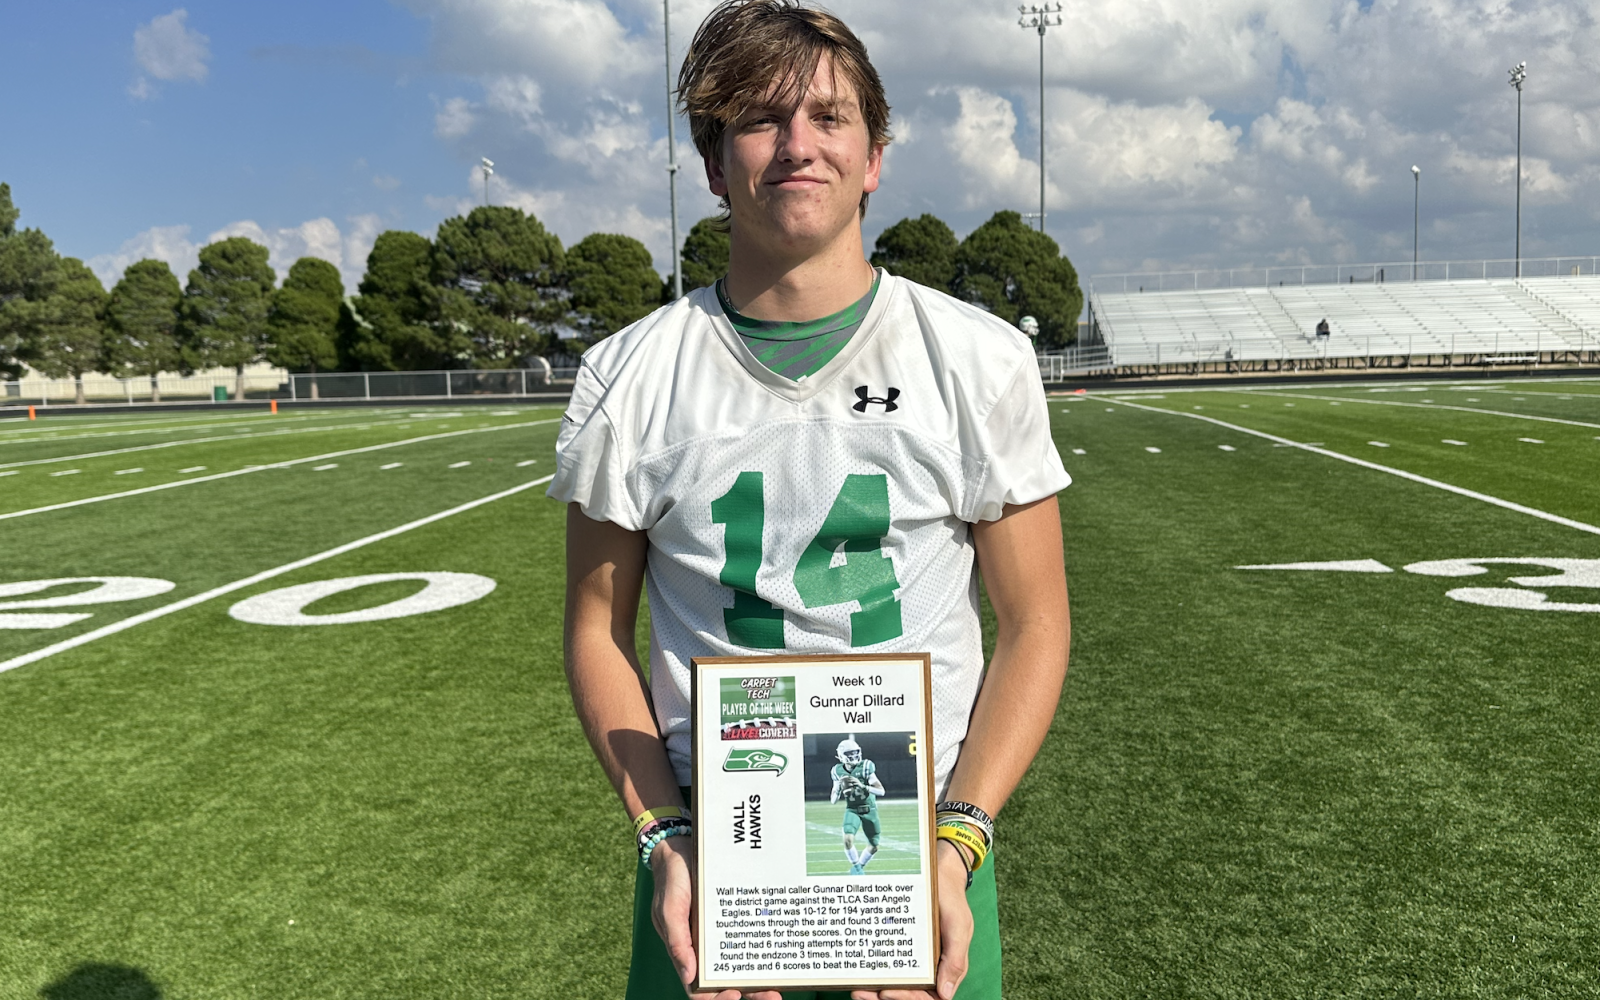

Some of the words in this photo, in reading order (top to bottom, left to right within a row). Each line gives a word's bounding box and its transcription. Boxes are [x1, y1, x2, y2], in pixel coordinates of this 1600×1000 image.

[711, 471, 903, 648] 14
[741, 677, 777, 688] CARPET
[832, 676, 865, 686] Week
[869, 675, 882, 686] 10
[747, 690, 770, 699] TECH
[810, 695, 859, 708] Gunnar
[863, 694, 904, 706] Dillard
[722, 703, 747, 715] PLAYER
[749, 703, 758, 715] OF
[761, 702, 772, 714] THE
[775, 702, 794, 714] WEEK
[843, 711, 871, 723] Wall
[945, 802, 971, 812] STAY
[733, 801, 746, 844] WALL
[749, 794, 762, 849] HAWKS
[716, 887, 734, 895] Wall
[736, 887, 760, 895] Hawk
[762, 886, 786, 896] signal
[788, 886, 810, 894] caller
[813, 885, 844, 893] Gunnar
[847, 884, 872, 892] Dillard
[875, 884, 893, 892] took
[720, 898, 732, 906] the
[735, 897, 762, 906] district
[764, 899, 787, 907] game
[790, 896, 820, 906] against
[822, 896, 835, 904] the
[837, 895, 861, 903] TLCA
[863, 895, 879, 903] San
[881, 895, 911, 904] Angelo
[722, 909, 752, 918] Eagles.
[755, 908, 781, 916] Dillard
[803, 907, 826, 915] 10-12
[829, 906, 840, 914] for
[843, 906, 858, 914] 194
[860, 906, 883, 916] yards
[885, 905, 901, 914] and
[904, 905, 909, 913] 3
[716, 920, 765, 928] touchdowns
[768, 918, 799, 928] through
[802, 918, 815, 926] the
[830, 917, 845, 925] and
[848, 916, 871, 925] found
[874, 916, 879, 924] 3
[882, 916, 915, 925] different
[725, 930, 771, 938] teammates
[773, 929, 785, 937] for
[787, 929, 809, 937] those
[844, 928, 857, 936] On
[860, 927, 872, 935] the
[875, 927, 907, 937] ground,
[720, 941, 746, 949] Dillard
[749, 940, 764, 949] had
[767, 940, 772, 948] 6
[774, 940, 804, 949] rushing
[807, 939, 843, 949] attempts
[859, 938, 868, 946] 51
[872, 938, 894, 948] yards
[897, 938, 912, 946] and
[720, 952, 743, 960] found
[746, 952, 759, 960] the
[762, 951, 797, 959] endzone
[800, 951, 805, 959] 3
[807, 950, 832, 958] times.
[835, 949, 843, 958] In
[845, 949, 865, 958] total,
[868, 949, 894, 957] Dillard
[897, 949, 912, 957] had
[714, 963, 729, 971] 245
[732, 963, 754, 973] yards
[757, 962, 772, 970] and
[775, 962, 781, 970] 6
[813, 961, 821, 969] to
[823, 960, 841, 969] beat
[844, 960, 857, 968] the
[860, 960, 891, 970] Eagles,
[893, 959, 920, 968] 69-12.
